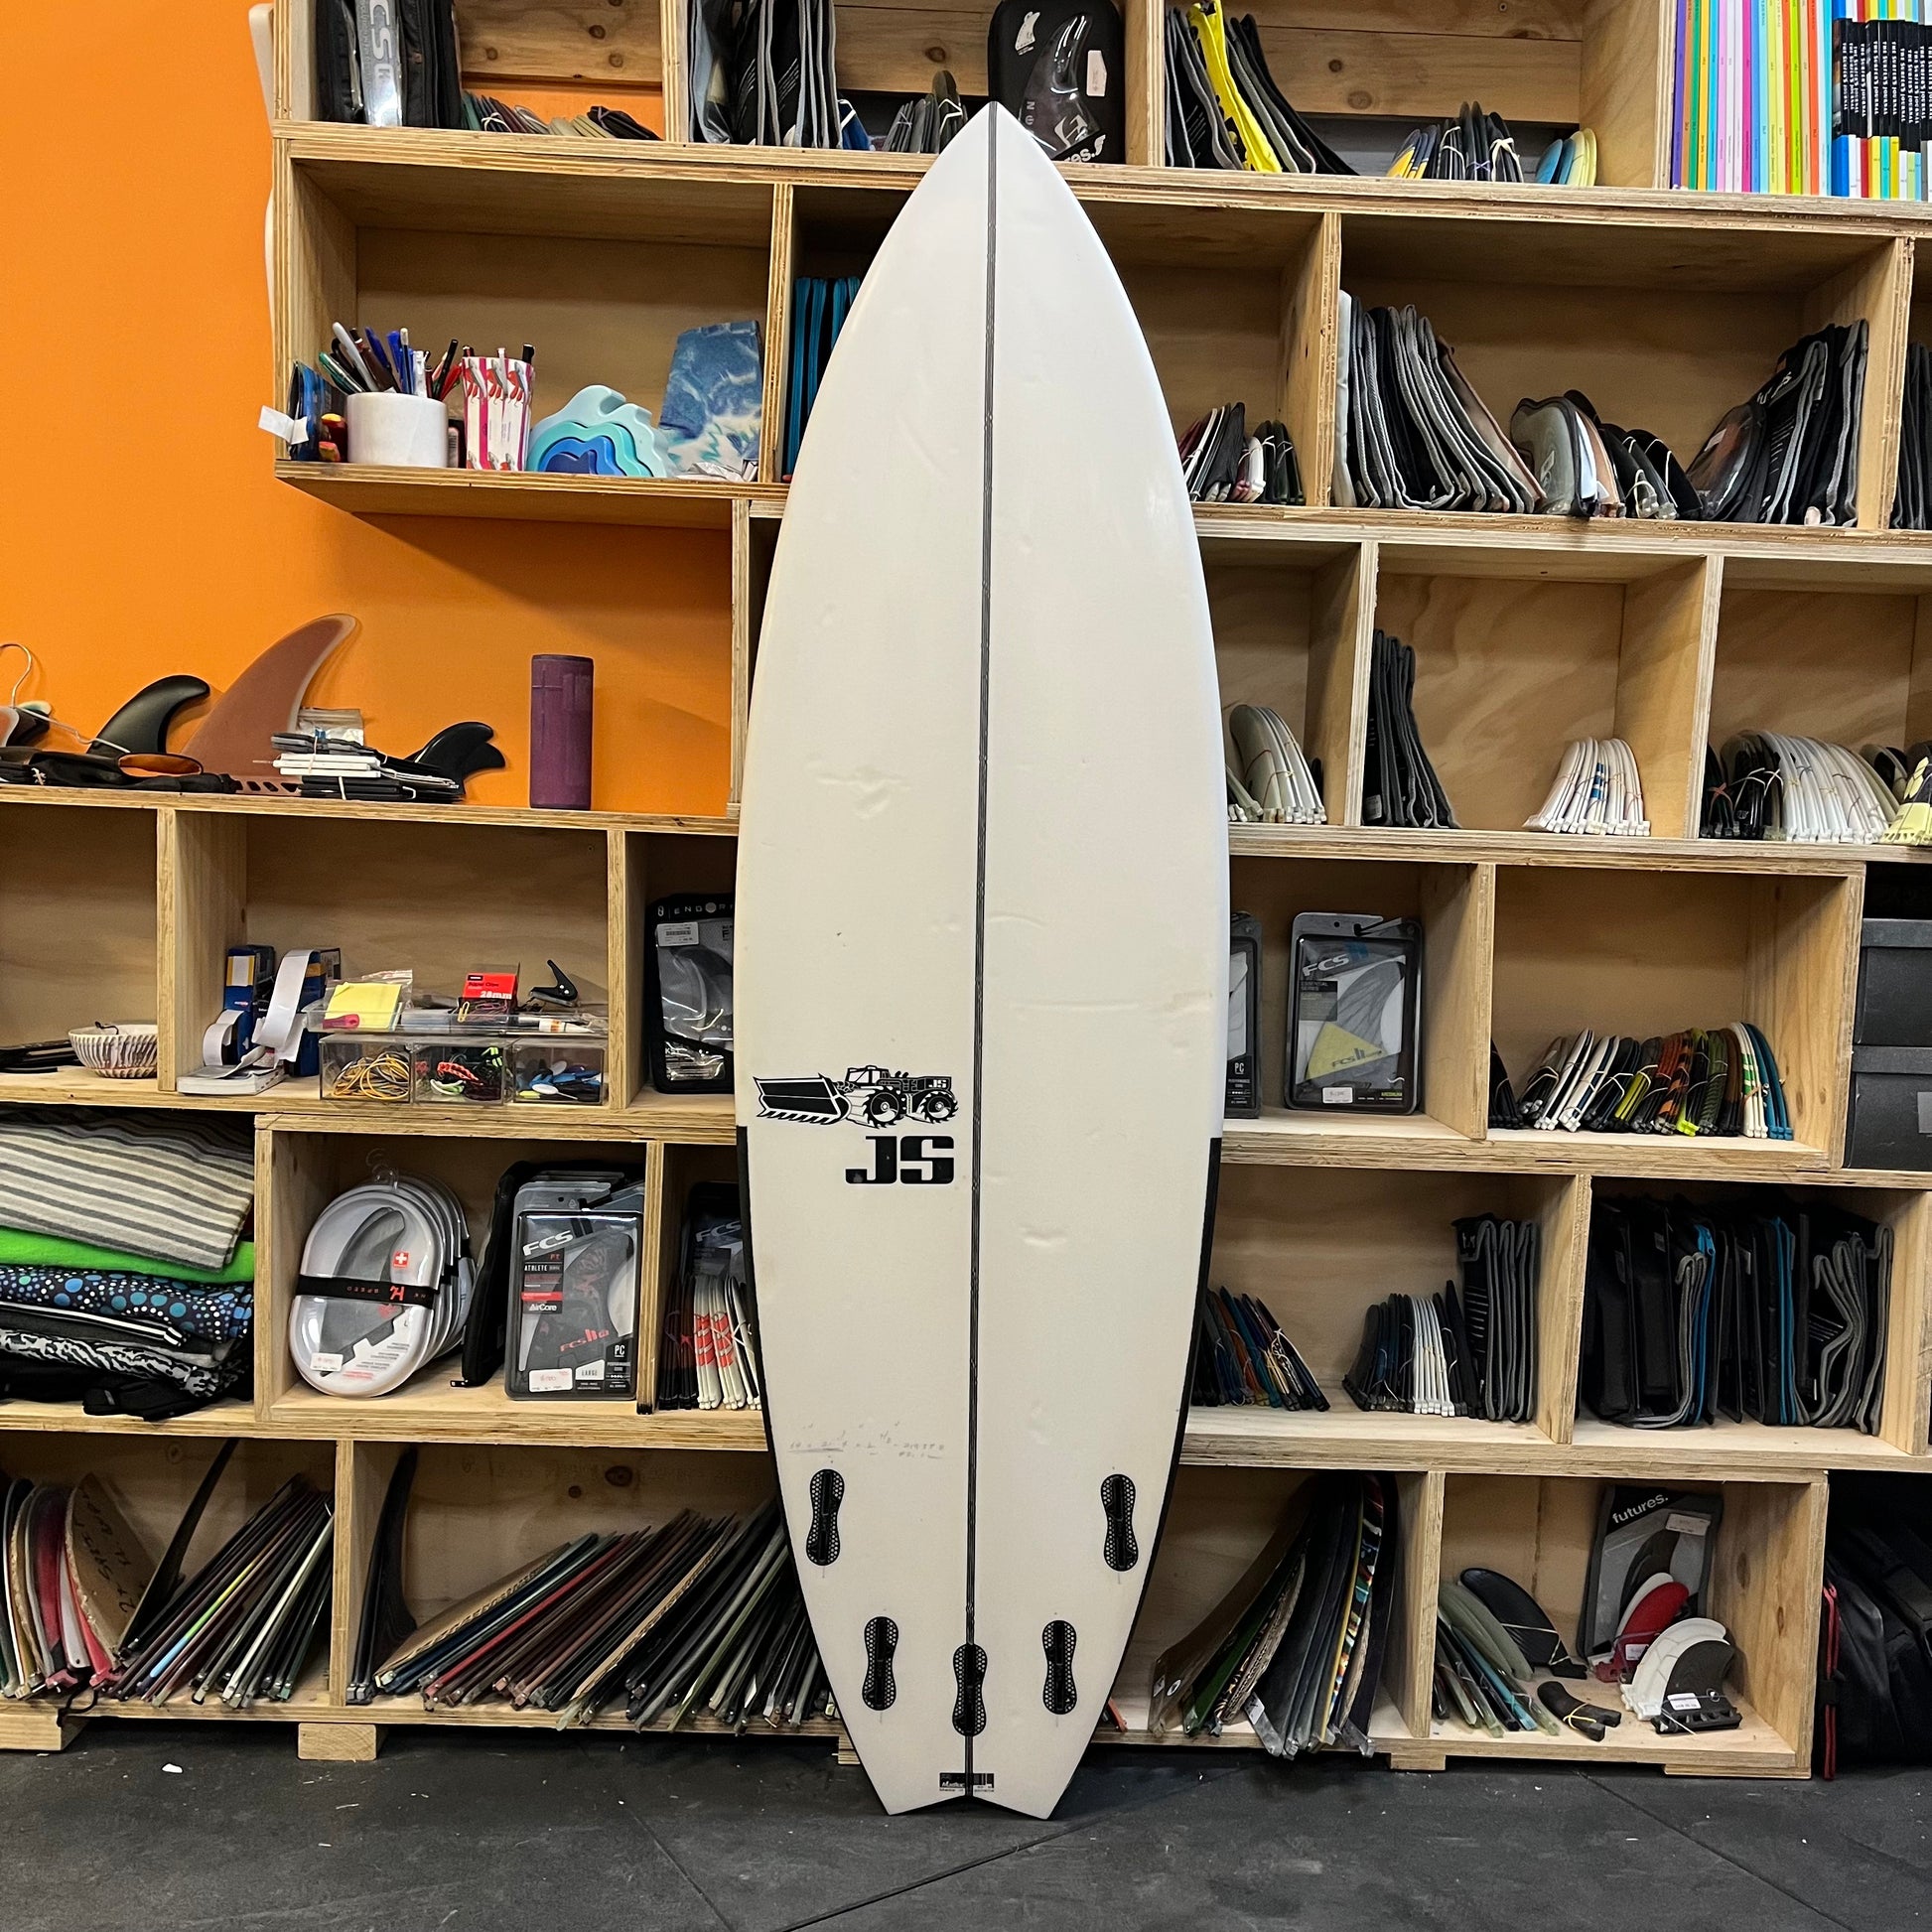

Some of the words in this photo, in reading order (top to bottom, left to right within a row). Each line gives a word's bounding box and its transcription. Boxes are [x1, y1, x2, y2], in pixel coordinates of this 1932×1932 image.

[1303, 953, 1350, 977] FCS
[481, 991, 512, 1000] 28mm
[1331, 1055, 1356, 1068] FCS
[928, 1079, 947, 1088] JS
[846, 1136, 954, 1184] JS
[696, 1220, 742, 1242] FCS
[522, 1229, 574, 1257] FCS
[560, 1339, 586, 1352] FCS
[614, 1345, 625, 1355] PC
[1611, 1492, 1669, 1524] futures.
